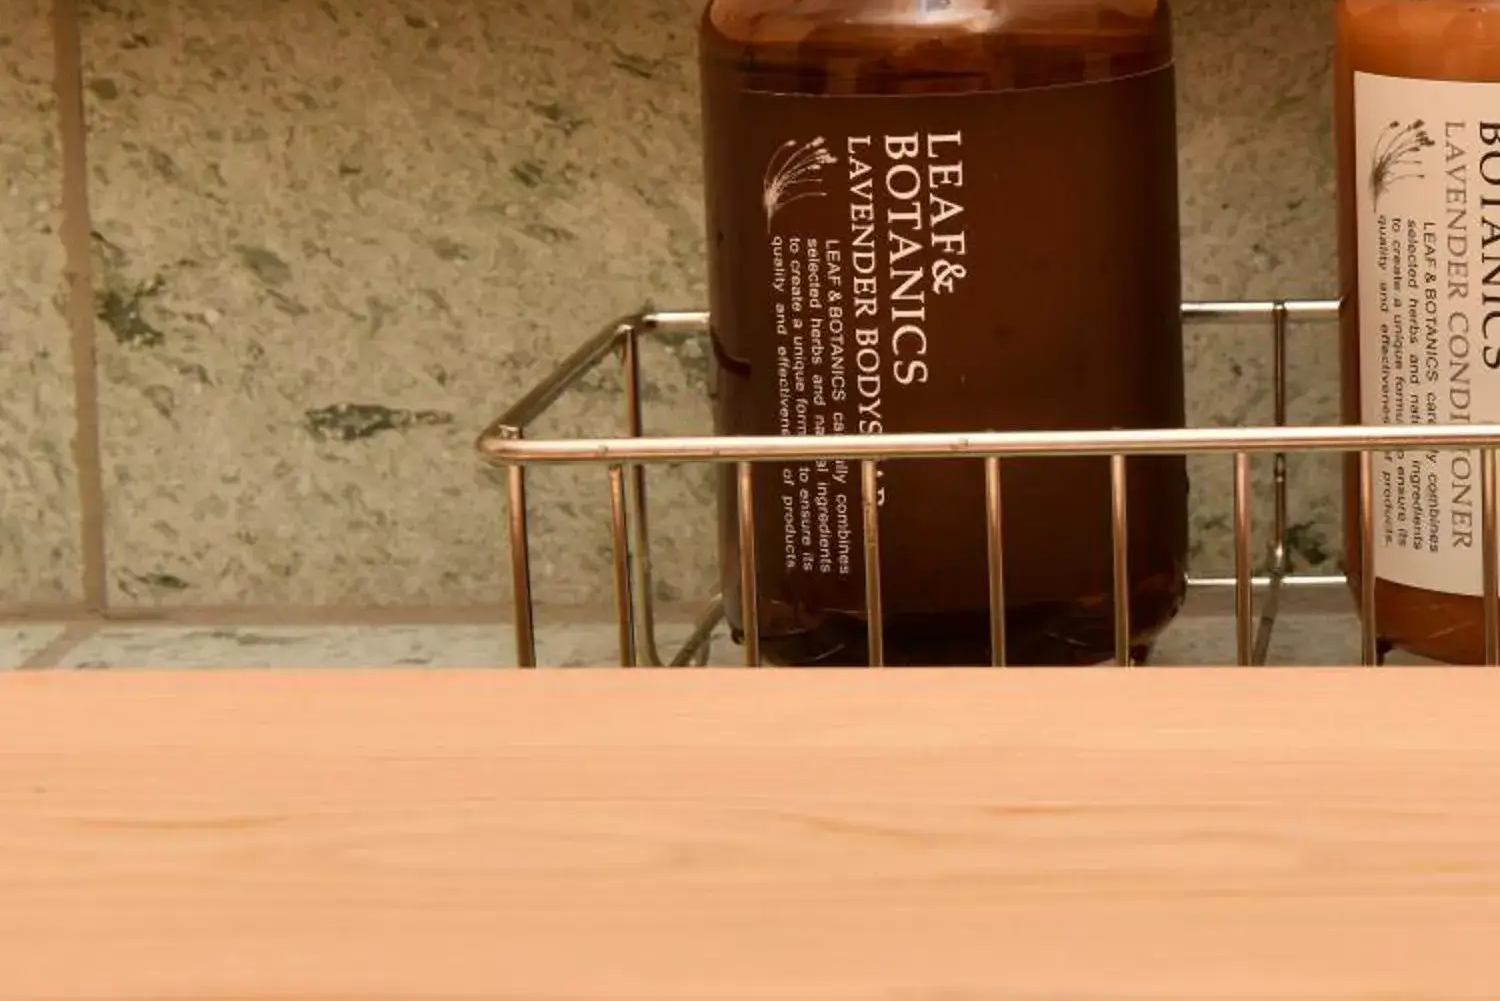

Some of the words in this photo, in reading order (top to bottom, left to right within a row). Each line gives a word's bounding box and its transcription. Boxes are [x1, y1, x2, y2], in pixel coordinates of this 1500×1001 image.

[848, 136, 878, 318] LAVENDER
[928, 131, 967, 295] LEAF&
[1392, 218, 1401, 232] to
[1445, 121, 1468, 299] LAVENDER
[772, 237, 786, 292] quality
[790, 238, 800, 252] to
[826, 240, 841, 285] LEAF
[884, 132, 928, 385] BOTANICS
[1377, 215, 1389, 271] quality
[1392, 240, 1403, 291] create
[1407, 219, 1418, 288] selected
[1424, 222, 1436, 268] LEAF
[791, 261, 802, 312] create
[807, 238, 822, 308] selected
[828, 291, 840, 301] &
[1380, 282, 1390, 312] and
[1425, 273, 1436, 283] &
[776, 303, 787, 335] and
[793, 319, 802, 328] a
[1394, 298, 1402, 307] a
[1410, 299, 1420, 343] herbs
[810, 319, 823, 364] herbs
[829, 307, 845, 401] BOTANICS
[1393, 315, 1404, 369] unique
[1425, 289, 1438, 381] BOTANICS
[792, 336, 806, 392] unique
[812, 375, 826, 405] and
[1410, 355, 1420, 384] and
[855, 329, 884, 507] BODYS
[1448, 311, 1473, 548] CONDIIONER
[783, 468, 794, 485] of
[800, 467, 810, 483] to
[1396, 466, 1406, 521] ensure
[800, 489, 812, 545] ensure
[814, 483, 832, 573] ingredients
[1410, 461, 1423, 549] ingredients
[1427, 474, 1440, 552] combines
[836, 494, 851, 574] combines
[802, 553, 814, 571] its
